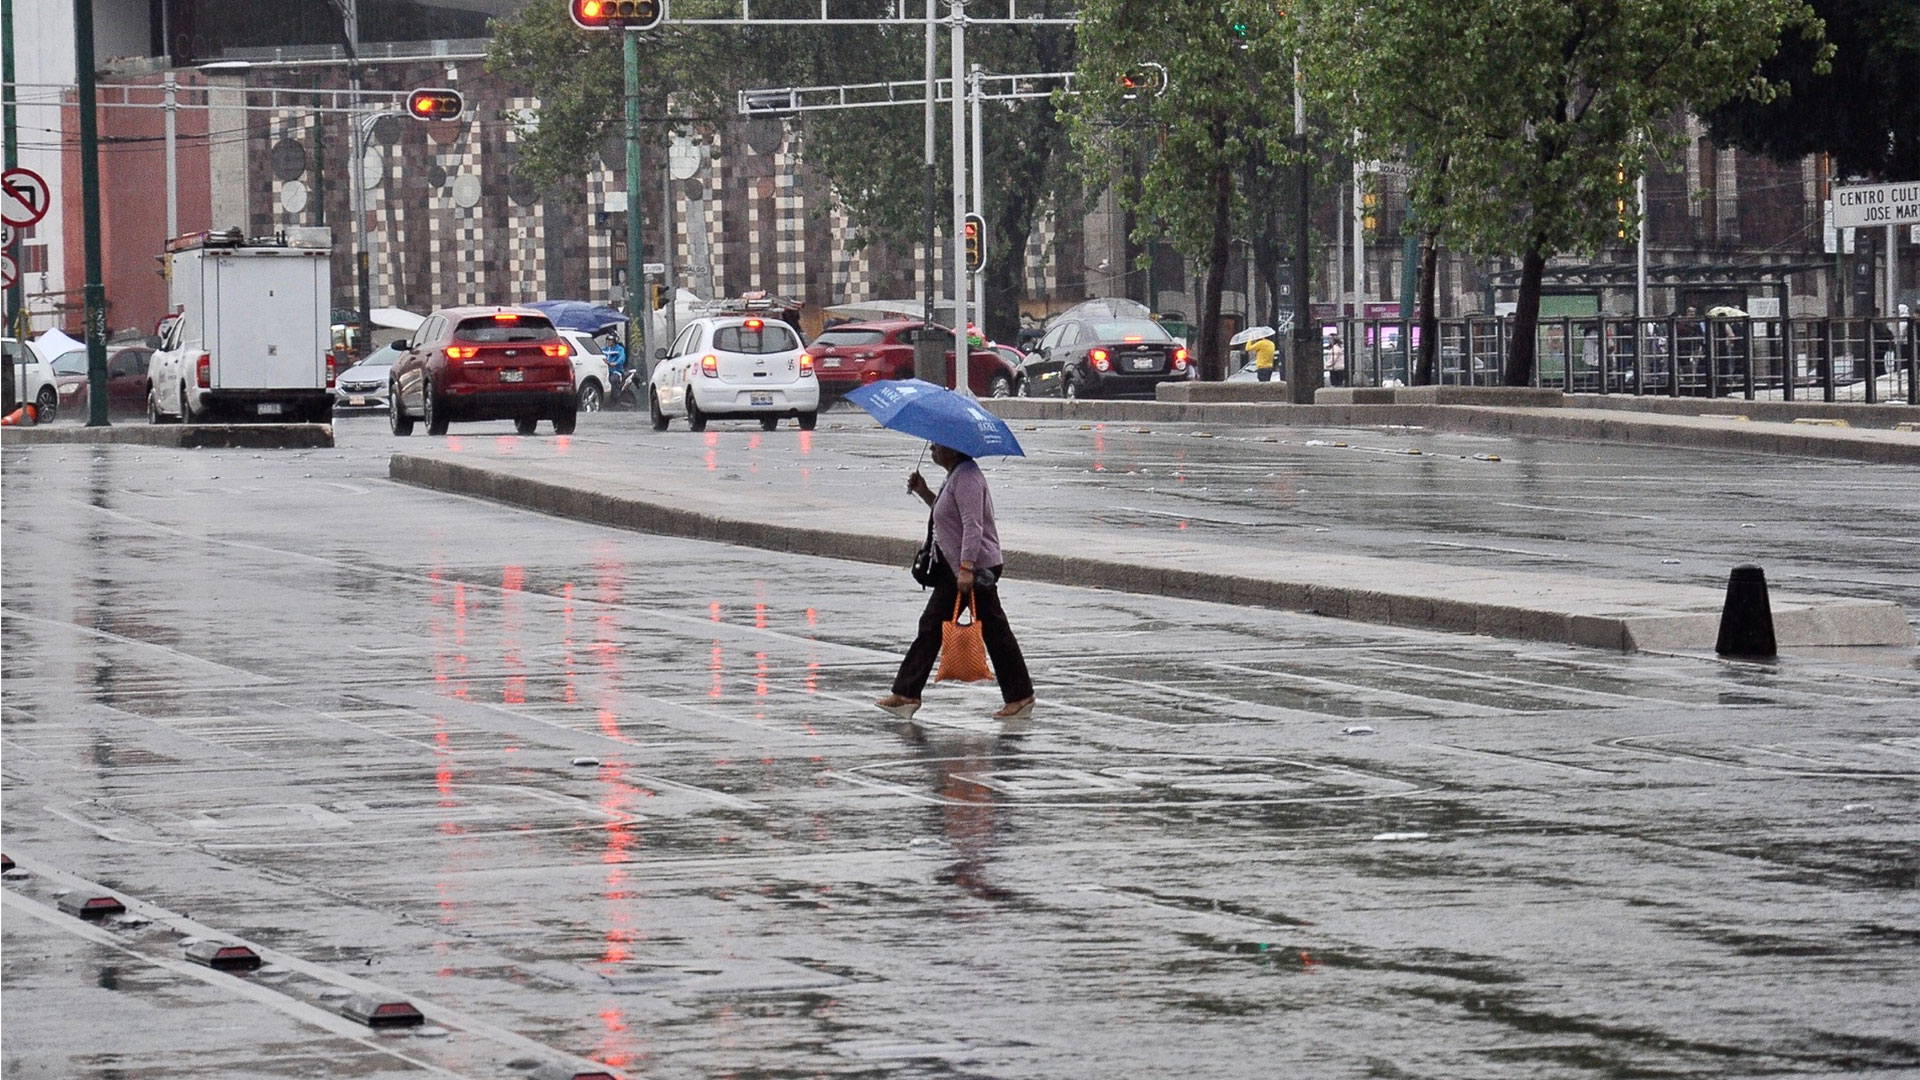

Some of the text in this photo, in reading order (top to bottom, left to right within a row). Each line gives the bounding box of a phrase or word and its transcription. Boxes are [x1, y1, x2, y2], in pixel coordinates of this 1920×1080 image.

[1839, 187, 1919, 206] CENTRO CULT
[1863, 204, 1920, 221] JOSE MAR
